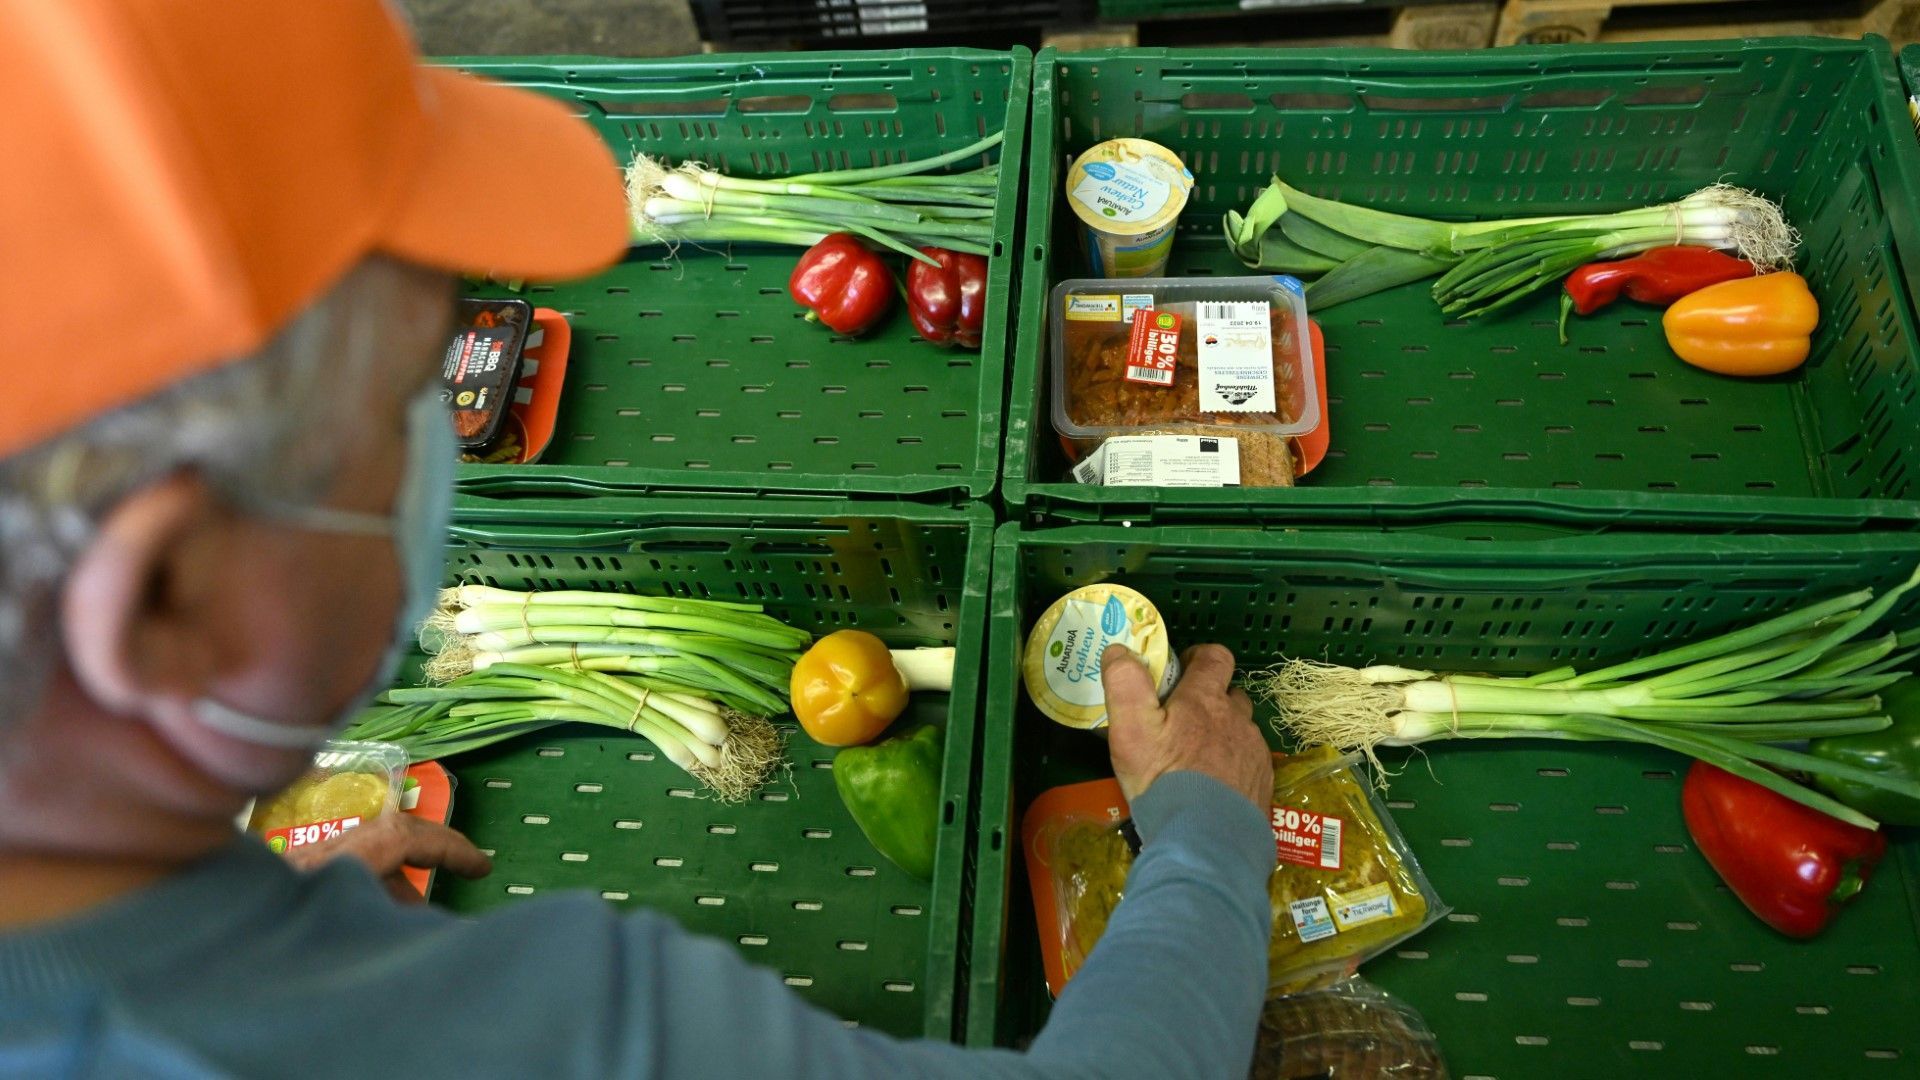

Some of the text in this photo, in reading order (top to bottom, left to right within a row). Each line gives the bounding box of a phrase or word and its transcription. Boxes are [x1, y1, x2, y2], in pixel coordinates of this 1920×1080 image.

[1100, 185, 1145, 210] Cashew
[1112, 179, 1149, 199] Natur
[483, 351, 501, 372] BBQ
[1143, 331, 1159, 367] billiger.
[1056, 629, 1079, 673] ALNATURA
[1067, 626, 1095, 683] Cashew
